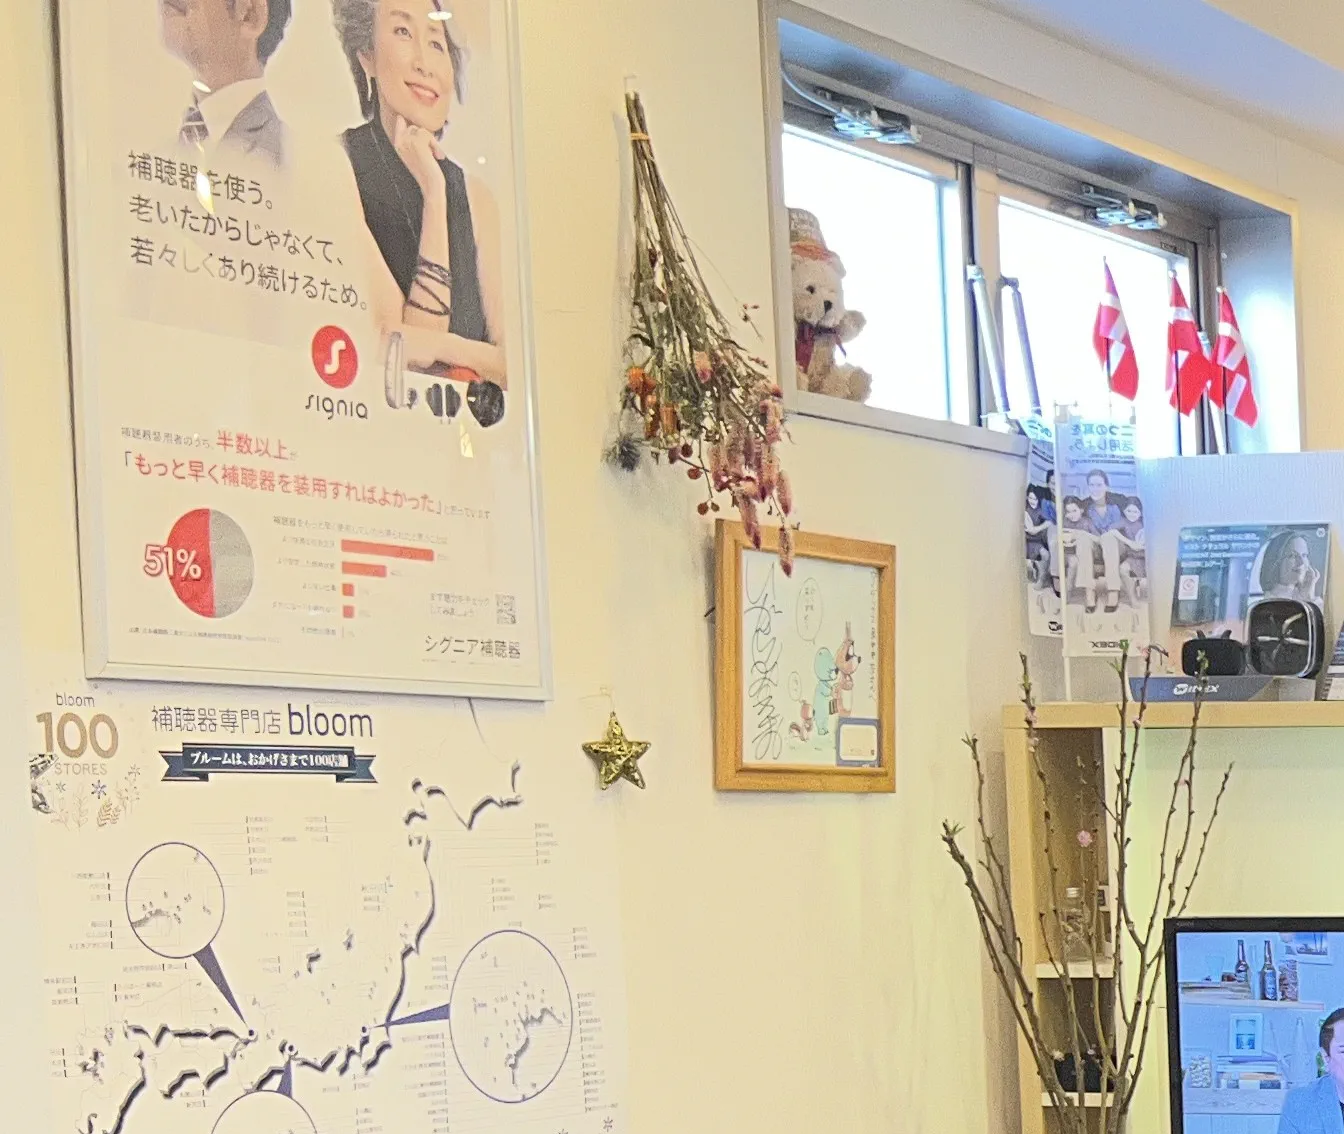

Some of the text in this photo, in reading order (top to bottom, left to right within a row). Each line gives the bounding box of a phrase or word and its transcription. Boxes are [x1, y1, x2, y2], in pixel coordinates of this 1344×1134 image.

[127, 150, 275, 212] 補聴器を使う。
[129, 194, 345, 268] 老いたからじゃなくて、
[130, 235, 368, 312] 若々しくあり続けるため。
[304, 394, 369, 421] signia
[144, 545, 201, 578] 51%
[425, 636, 521, 660] シグニア補聴器
[56, 692, 95, 707] bloom
[36, 711, 119, 760] 100
[151, 703, 373, 737] 補聴器専門店 bloom
[55, 763, 107, 776] STORES
